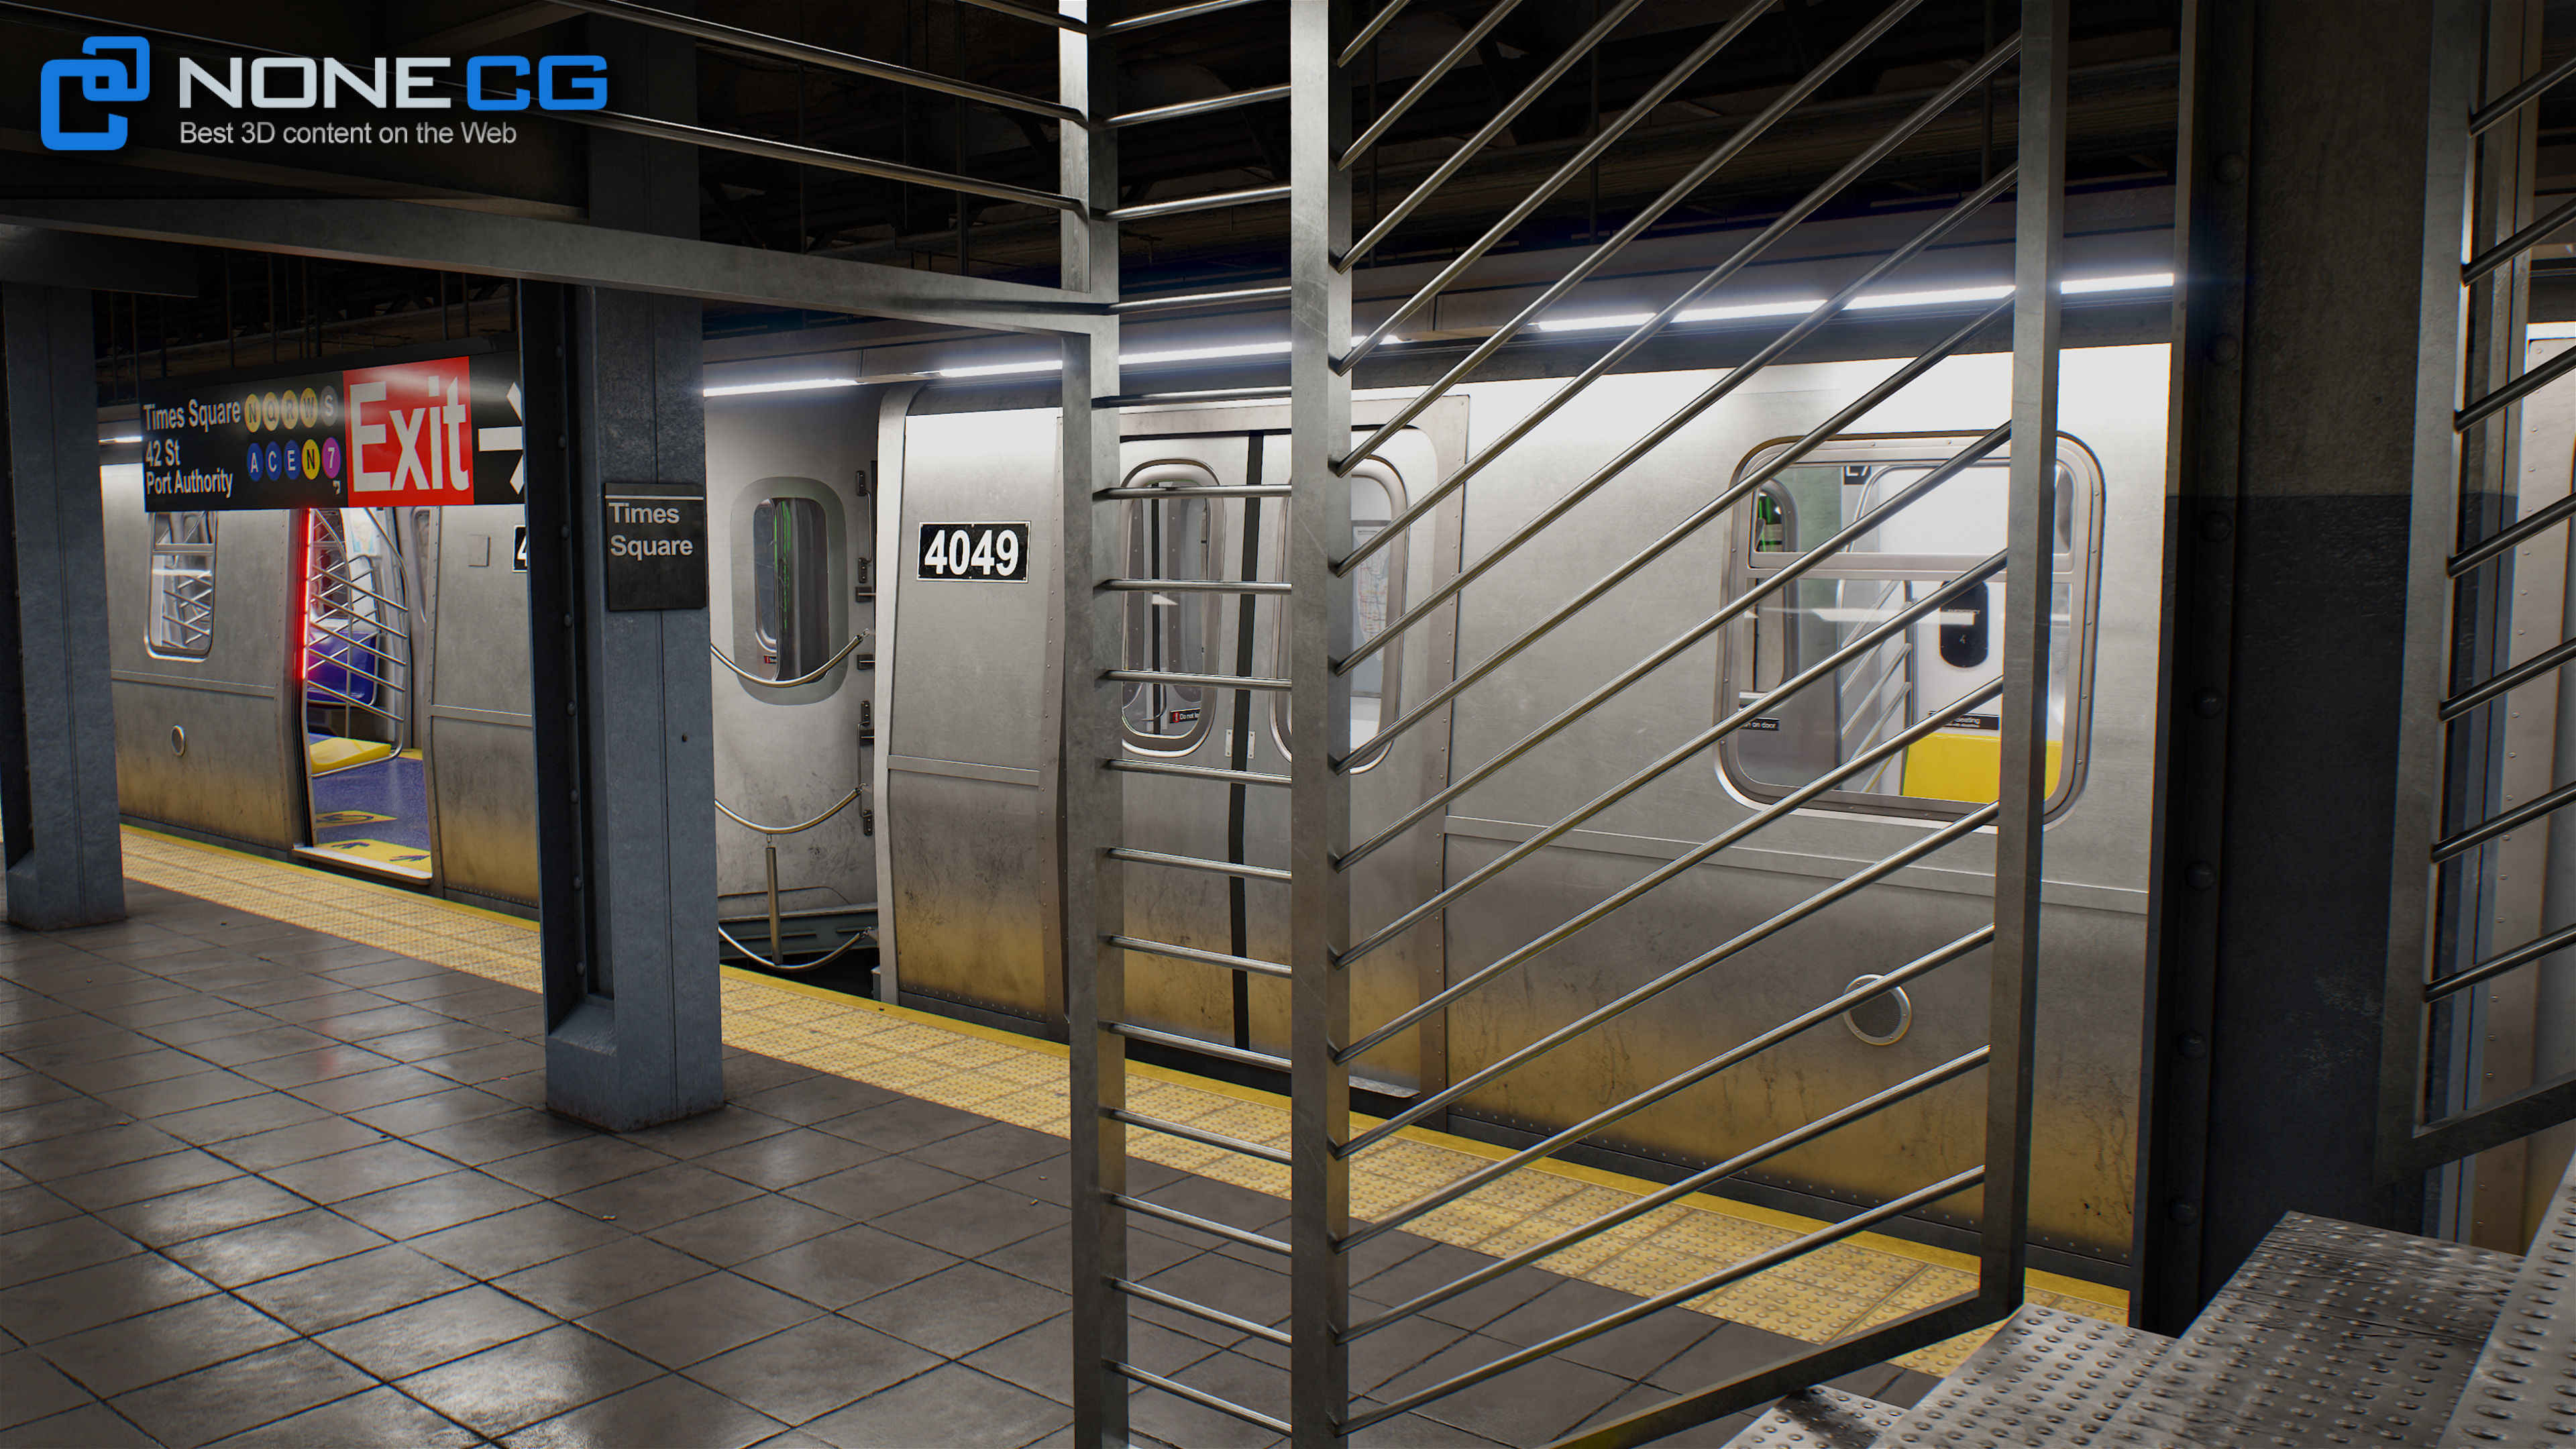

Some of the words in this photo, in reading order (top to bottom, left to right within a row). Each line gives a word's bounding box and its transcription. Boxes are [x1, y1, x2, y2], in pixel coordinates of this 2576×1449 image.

[143, 403, 185, 431] Times
[188, 398, 241, 433] Square
[350, 376, 470, 492] Exit
[146, 440, 162, 467] 42
[165, 438, 181, 466] St
[146, 471, 172, 494] Port
[174, 467, 233, 498] Authority
[608, 502, 680, 523] Times
[610, 535, 693, 561] Square
[924, 529, 1019, 576] 4049
